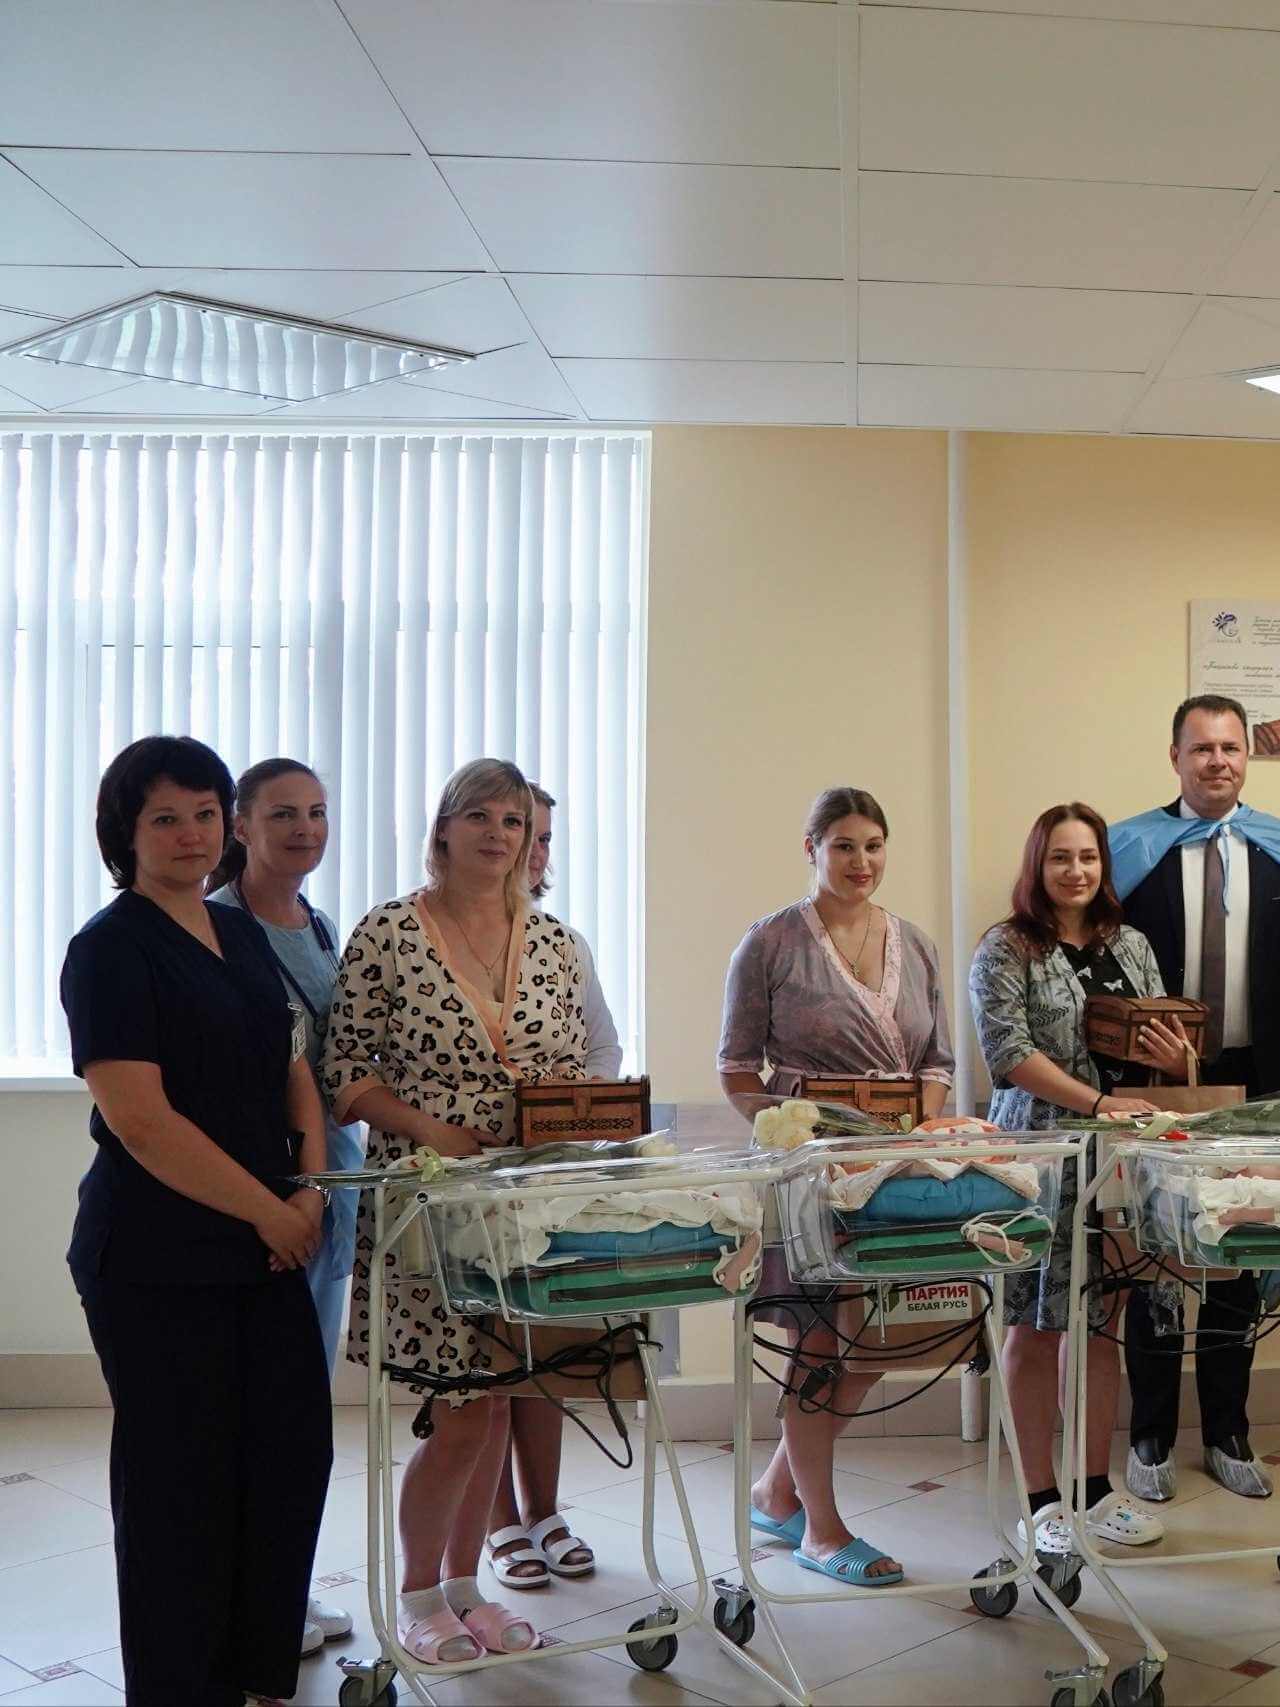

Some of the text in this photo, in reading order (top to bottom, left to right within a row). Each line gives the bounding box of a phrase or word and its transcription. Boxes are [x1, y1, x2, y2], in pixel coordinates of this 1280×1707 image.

[905, 1285, 969, 1301] ПАРТИЯ
[907, 1300, 968, 1311] БЕЛАЯ РУСЬ
